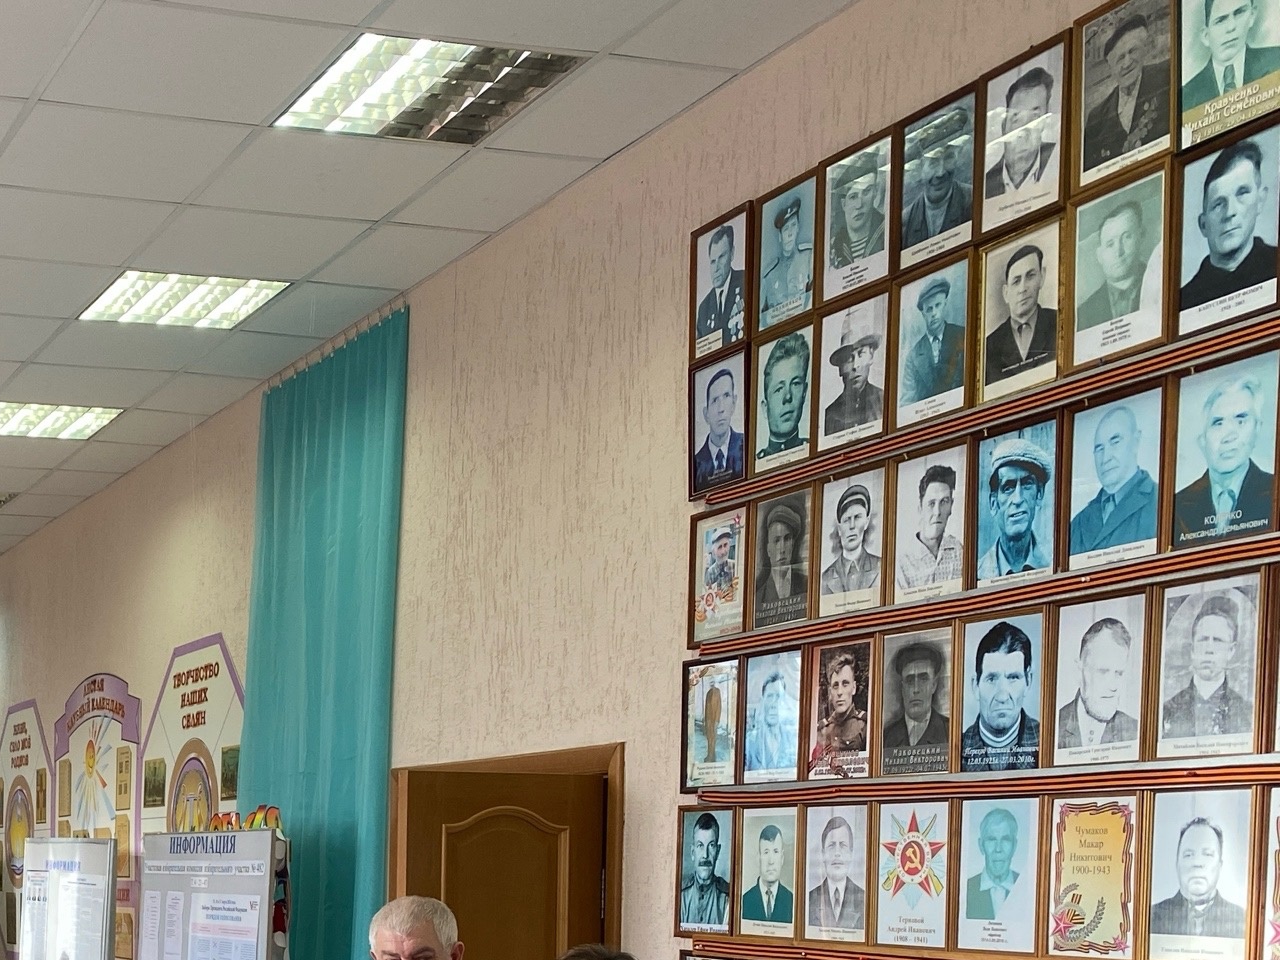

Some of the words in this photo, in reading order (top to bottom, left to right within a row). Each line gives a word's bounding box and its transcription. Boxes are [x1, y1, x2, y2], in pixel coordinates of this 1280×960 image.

[1204, 84, 1260, 115] Кравченко
[1180, 528, 1218, 541] Александр
[173, 661, 220, 689] ТВОРЧЕСТВО
[180, 687, 208, 709] НАШИХ
[91, 696, 125, 718] КАЛЕНДАРЬ
[182, 710, 206, 730] СЕЛЯН
[893, 747, 940, 757] Маковецкий
[910, 755, 949, 764] Викторович
[1075, 826, 1109, 837] Чумаков
[169, 834, 236, 856] ИНФОРМАЦИЯ
[1079, 839, 1104, 850] Макар
[1070, 852, 1112, 861] Никитович
[1072, 865, 1111, 875] 1900-1943
